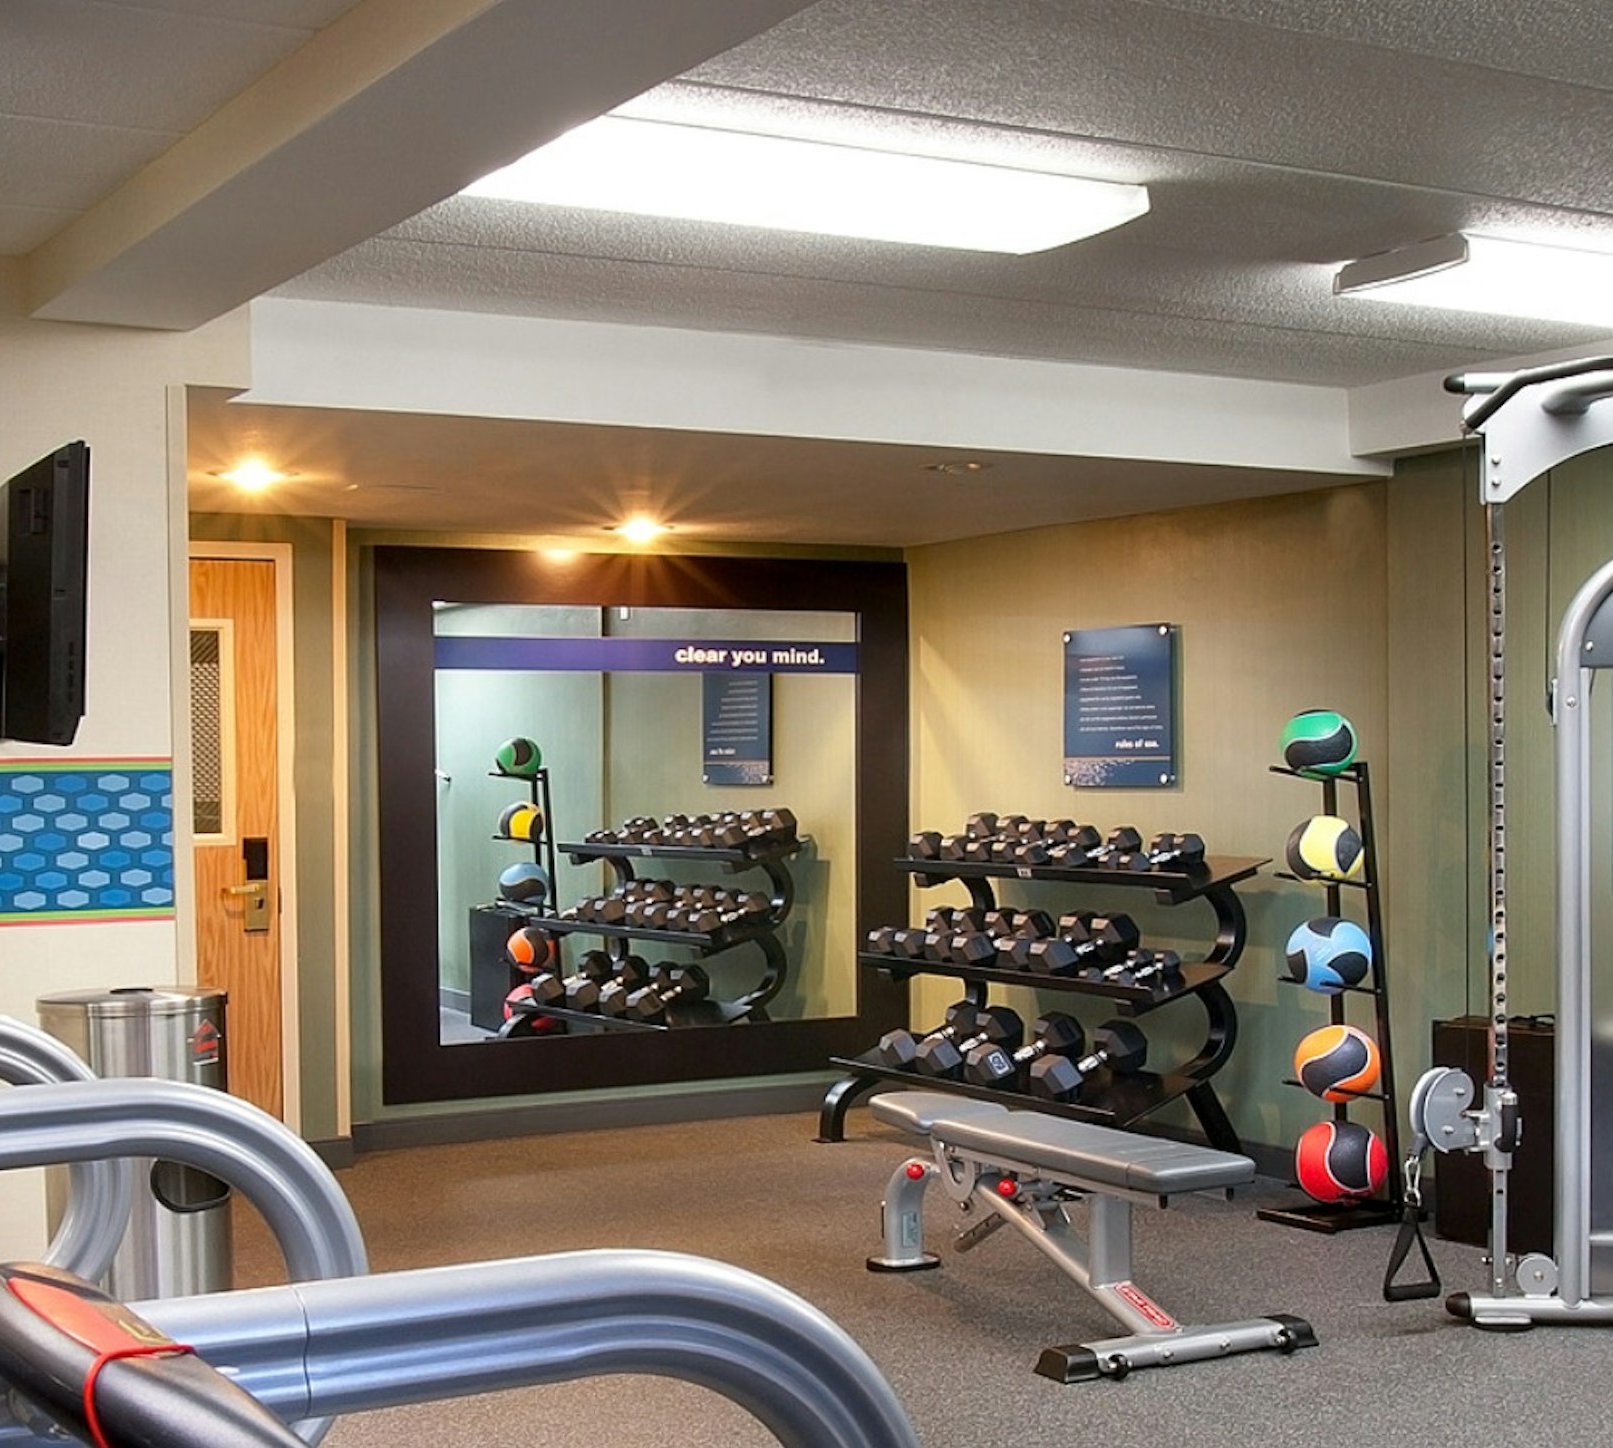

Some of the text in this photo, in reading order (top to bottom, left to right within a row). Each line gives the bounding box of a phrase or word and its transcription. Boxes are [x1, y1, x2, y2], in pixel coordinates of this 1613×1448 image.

[674, 646, 825, 667] clear you mind.
